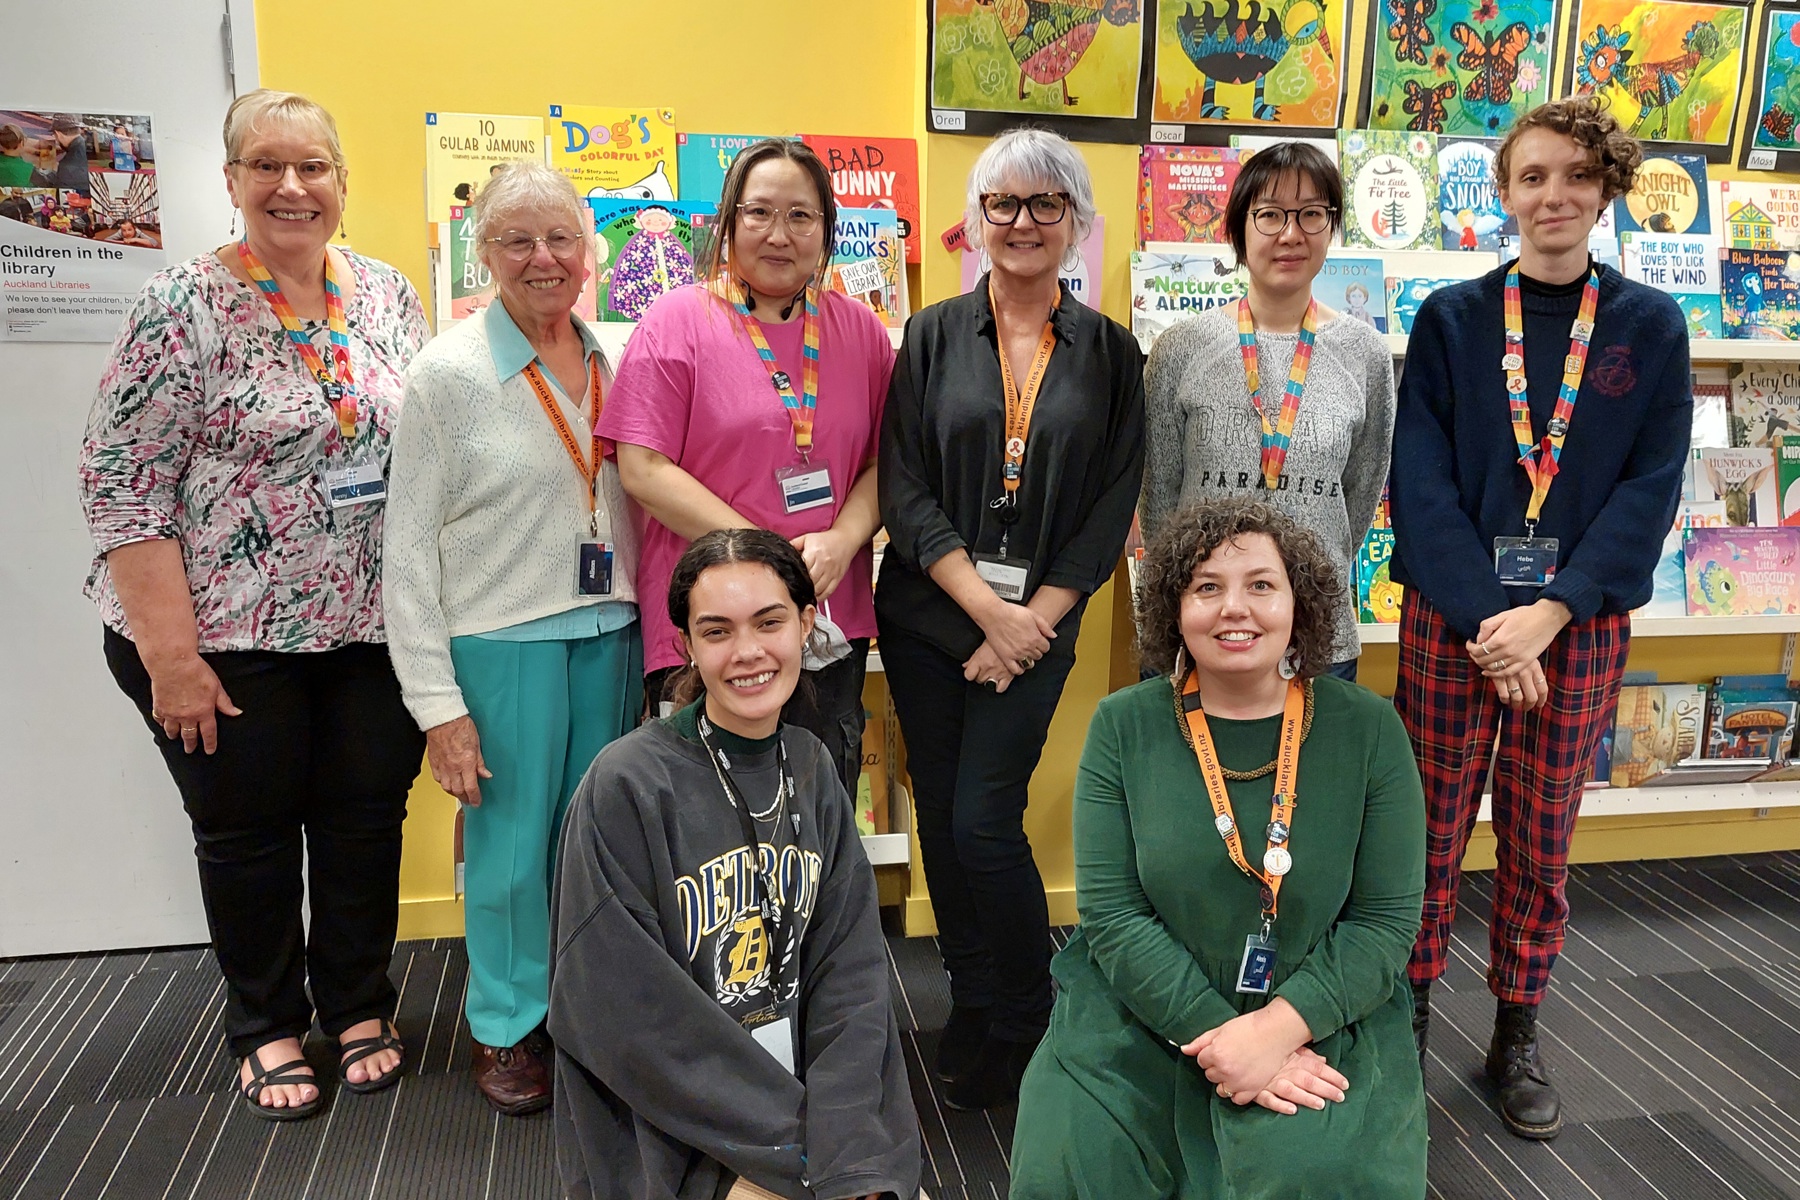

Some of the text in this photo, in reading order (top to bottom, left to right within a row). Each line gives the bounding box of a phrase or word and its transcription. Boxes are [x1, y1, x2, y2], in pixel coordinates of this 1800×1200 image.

[935, 114, 961, 126] Oren
[479, 119, 495, 137] 10
[561, 114, 651, 153] Dog's
[1155, 130, 1182, 141] Oscar
[439, 136, 535, 154] GULAB JAMUNS
[710, 137, 717, 148] I
[719, 137, 748, 149] LOVE
[580, 147, 665, 162] COLORFUL DAY
[828, 145, 884, 173] BAD
[1750, 155, 1774, 166] Moss
[1169, 164, 1225, 177] NOVA'S
[1458, 160, 1481, 176] BOY
[829, 170, 897, 197] UNNY
[1178, 176, 1216, 185] MISSING
[1372, 177, 1407, 188] The Little
[1168, 183, 1228, 192] MASTERPIECE
[1368, 186, 1411, 199] Fir Tree
[1646, 193, 1680, 212] OWL
[1766, 201, 1799, 213] GOING
[619, 205, 640, 214] was
[671, 207, 685, 216] an
[613, 217, 636, 230] who
[1777, 214, 1799, 228] PIC
[627, 229, 635, 237] a
[0, 244, 123, 260] Children in the
[1640, 241, 1704, 255] THE BOY WHO
[1640, 254, 1705, 268] LOVES TO LICK
[1732, 251, 1786, 267] Blue Baboon
[2, 261, 56, 277] library
[842, 261, 878, 281] SAVE OUR
[1342, 265, 1369, 276] BOY
[1642, 267, 1707, 286] THE WIND
[4, 280, 91, 290] Auckland Libraries
[847, 274, 882, 295] LIBRARY
[1154, 275, 1248, 295] Nature's
[1764, 277, 1799, 290] Her Tune
[5, 294, 20, 303] We
[22, 294, 39, 303] love
[41, 295, 49, 303] to
[68, 297, 86, 308] your
[88, 296, 123, 305] children,
[7, 306, 123, 318] please don't leave them here
[1750, 372, 1779, 394] Every
[1767, 394, 1774, 405] a
[1725, 469, 1747, 479] EGG
[1200, 471, 1340, 498] PARADISE
[1516, 555, 1534, 563] Hebe
[1756, 560, 1777, 570] Little
[1740, 570, 1796, 586] Dinosaur's
[1747, 584, 1789, 597] Big Race
[1740, 712, 1773, 720] HOTEL
[1728, 719, 1784, 728] FANTASTIC
